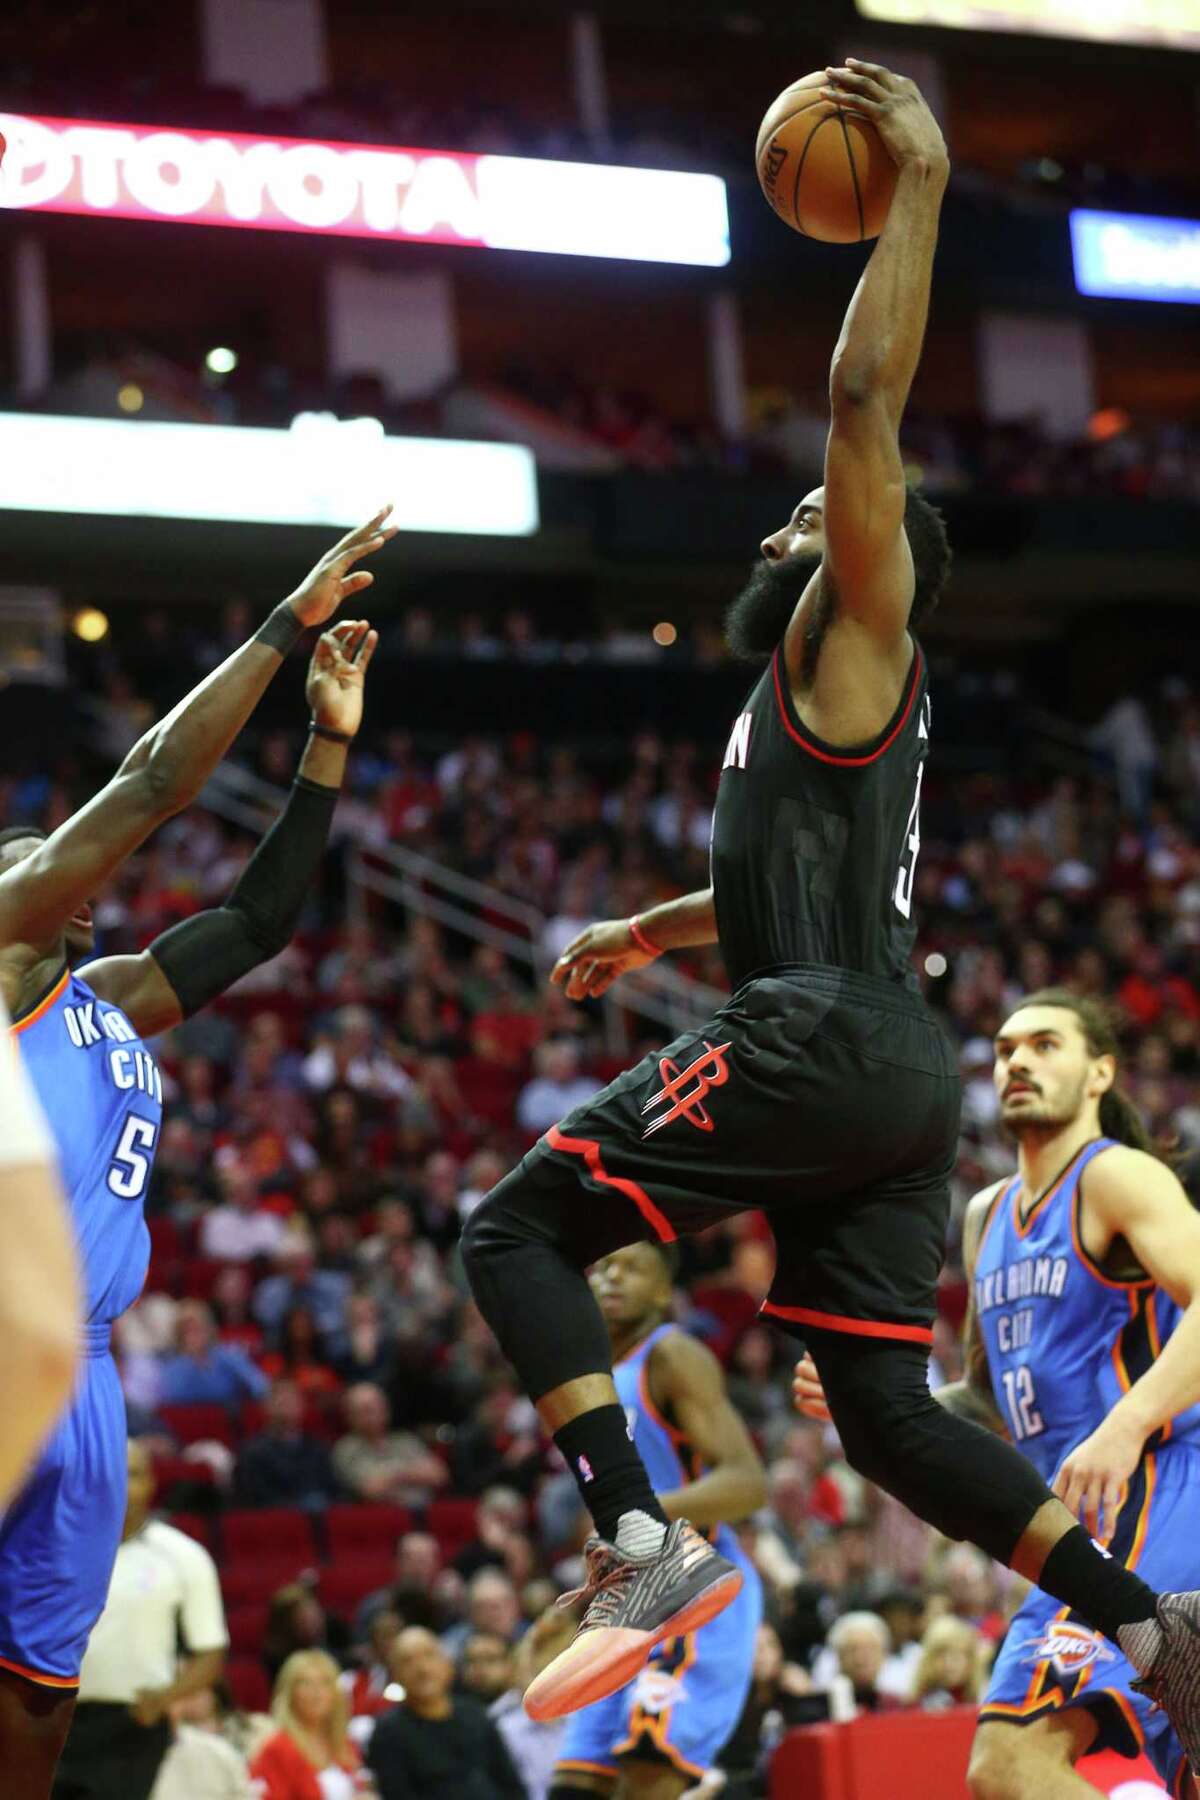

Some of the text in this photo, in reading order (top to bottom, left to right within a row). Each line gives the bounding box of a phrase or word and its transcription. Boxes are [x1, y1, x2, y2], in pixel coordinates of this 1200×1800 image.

[62, 126, 484, 238] TOYOTA
[107, 1114, 157, 1199] 5
[1002, 1365, 1044, 1440] 12
